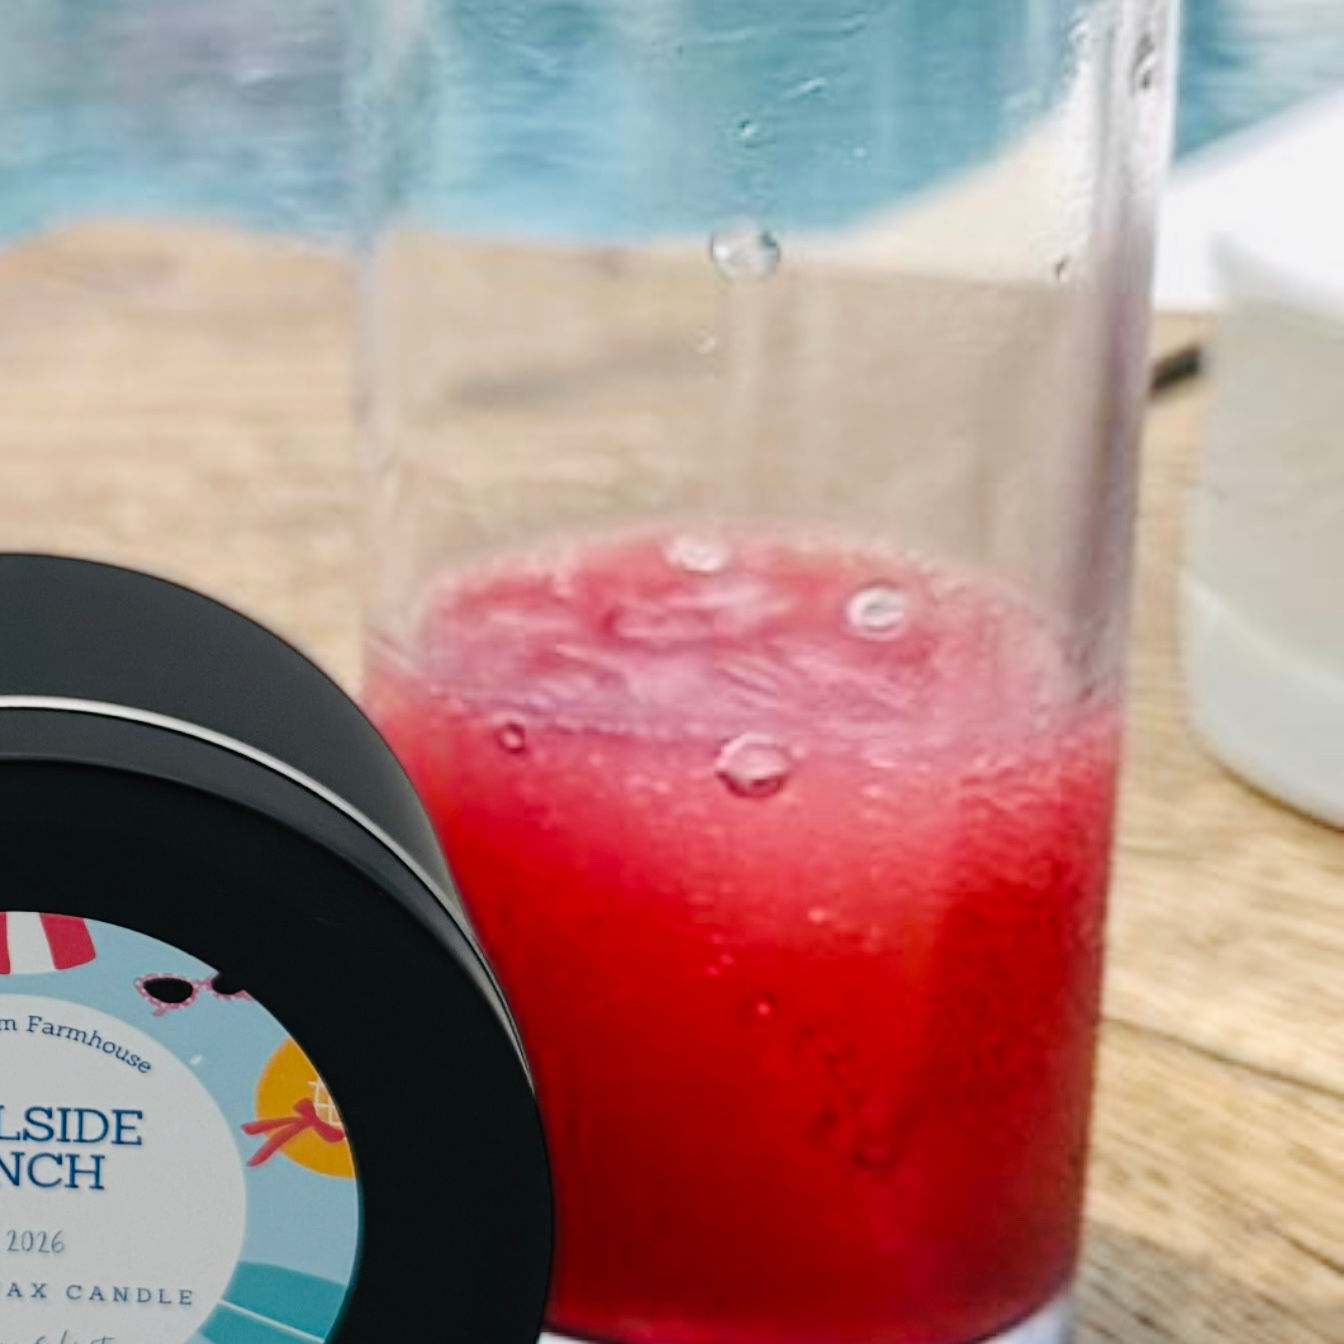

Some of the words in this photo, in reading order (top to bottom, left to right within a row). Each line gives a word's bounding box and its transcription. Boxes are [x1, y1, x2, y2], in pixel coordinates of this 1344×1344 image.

[26, 1015, 152, 1074] Farmhouse
[8, 1230, 65, 1254] 2026
[66, 1284, 193, 1306] CANDLE
